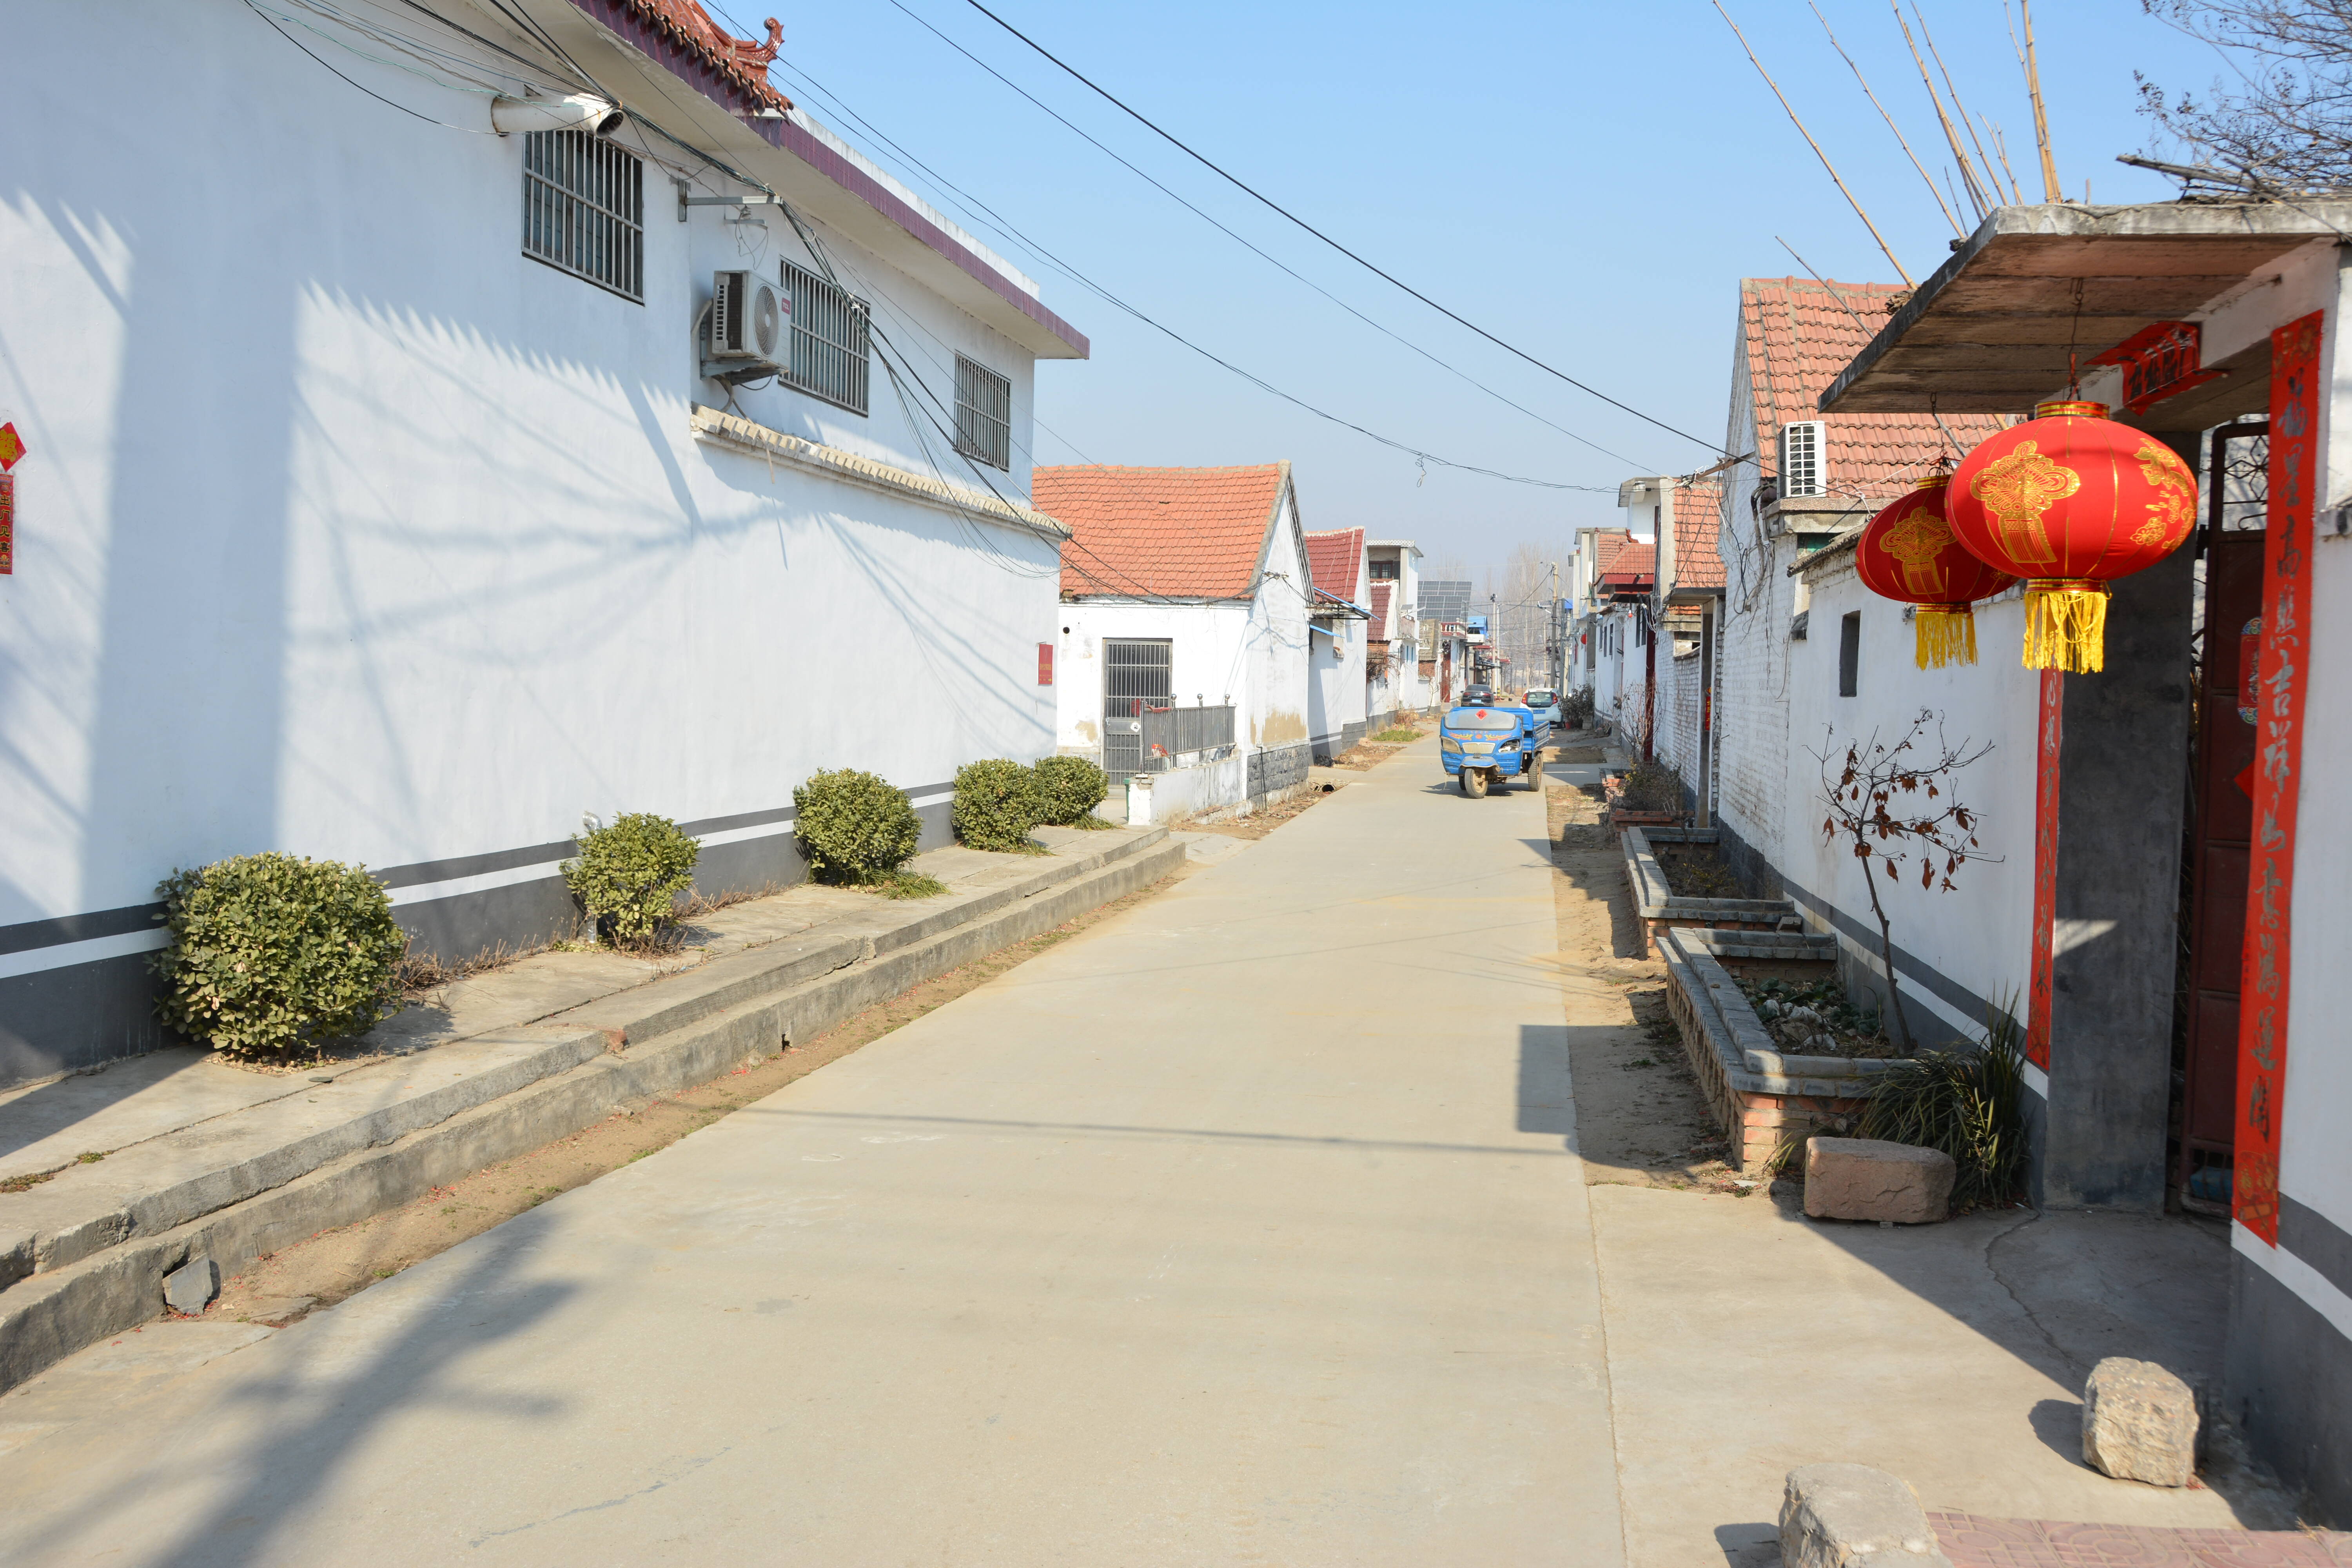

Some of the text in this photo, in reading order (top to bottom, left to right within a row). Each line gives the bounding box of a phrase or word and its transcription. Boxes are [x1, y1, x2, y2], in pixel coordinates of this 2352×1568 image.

[0, 429, 17, 462] 福
[0, 494, 11, 553] 出门见喜
